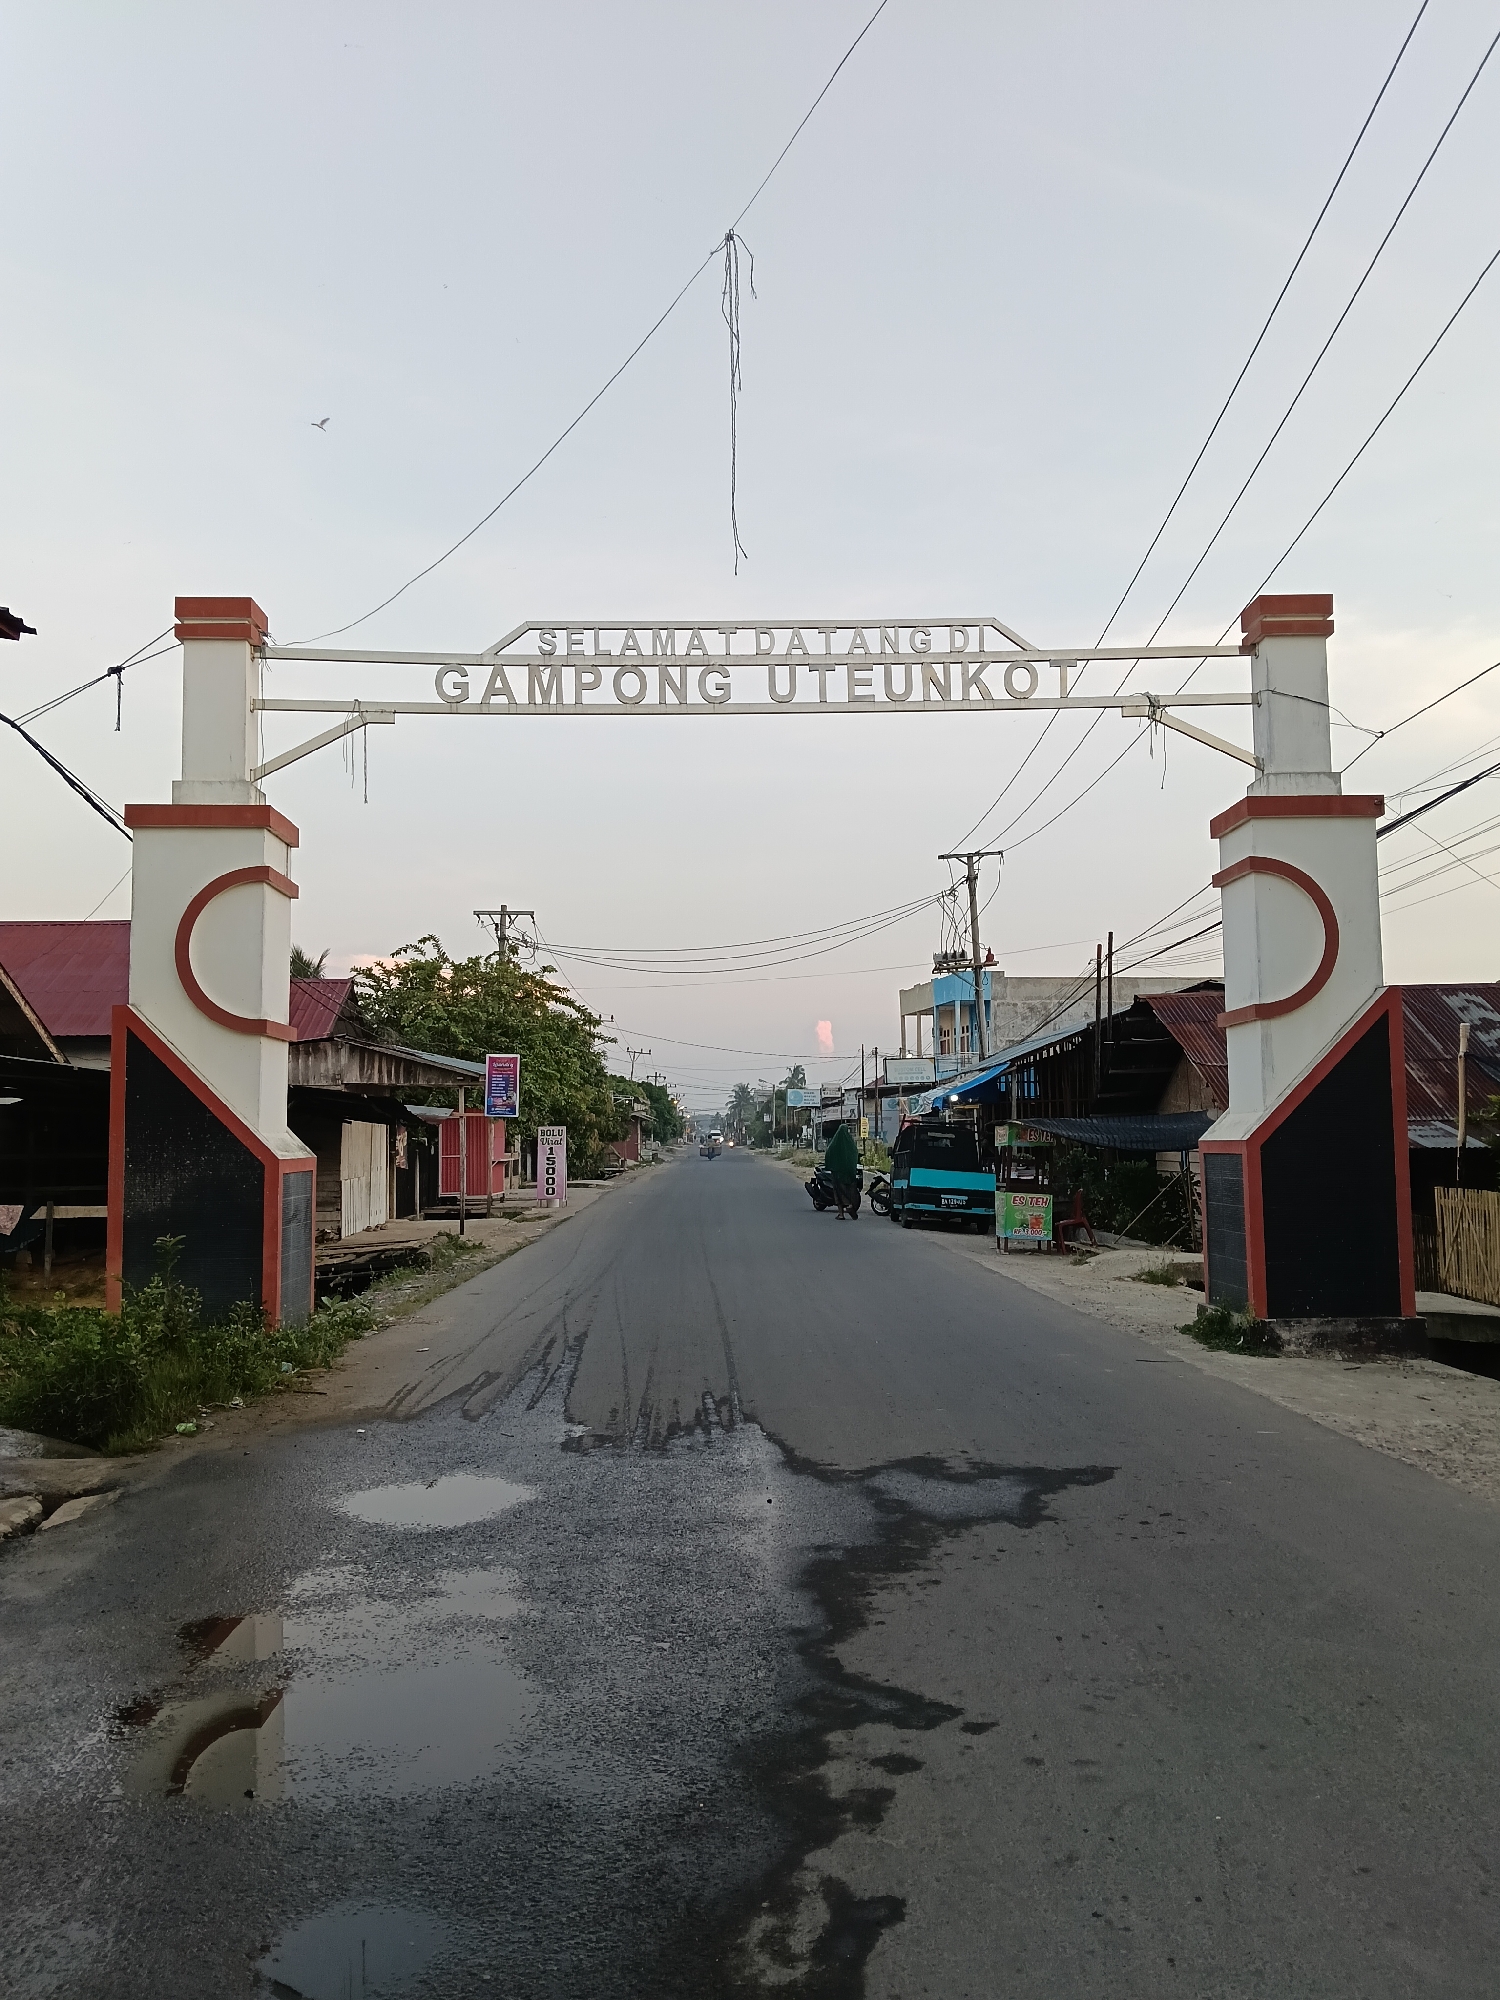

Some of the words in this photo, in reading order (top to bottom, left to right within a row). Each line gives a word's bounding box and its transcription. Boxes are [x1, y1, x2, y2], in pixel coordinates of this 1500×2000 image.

[538, 626, 737, 655] SELAMAT
[755, 626, 932, 655] DATANG
[950, 625, 985, 652] DI
[434, 663, 731, 704] GAMPONG
[768, 660, 1077, 703] UTEUNKOT
[1027, 1128, 1040, 1142] ES
[1011, 1195, 1026, 1205] ES
[1028, 1196, 1049, 1207] TEH
